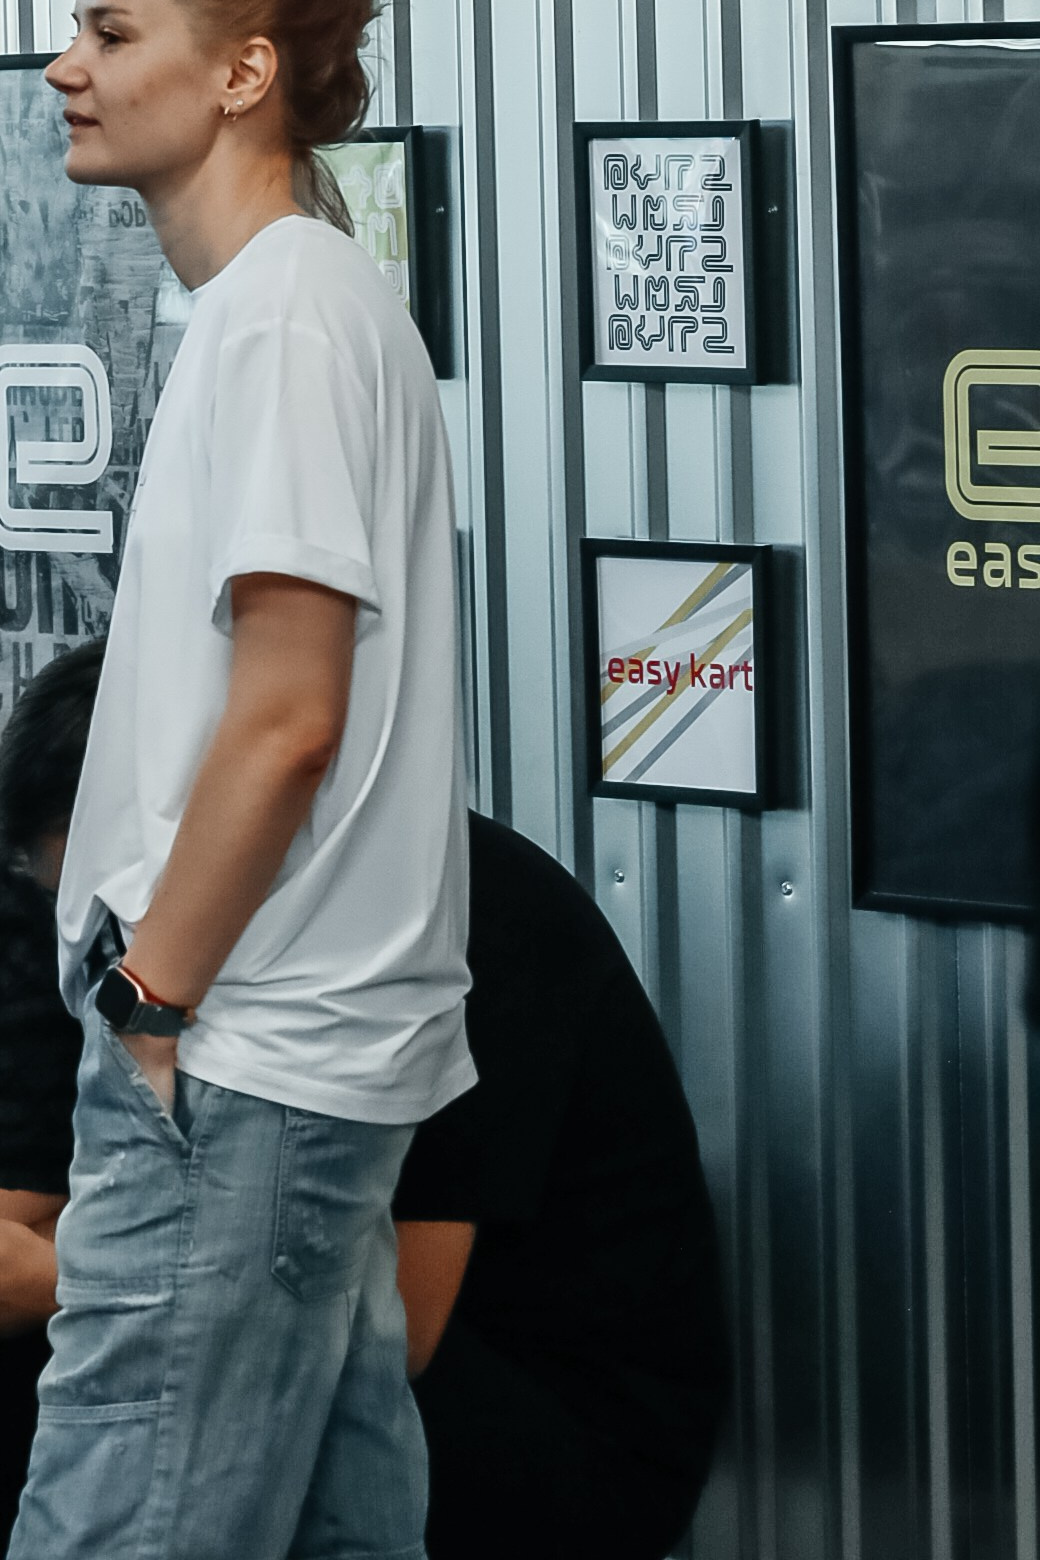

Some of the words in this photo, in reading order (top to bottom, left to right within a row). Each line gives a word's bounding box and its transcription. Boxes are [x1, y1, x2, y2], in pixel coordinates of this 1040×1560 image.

[946, 541, 1040, 590] eas
[607, 657, 681, 695] easy
[690, 652, 753, 692] kart
